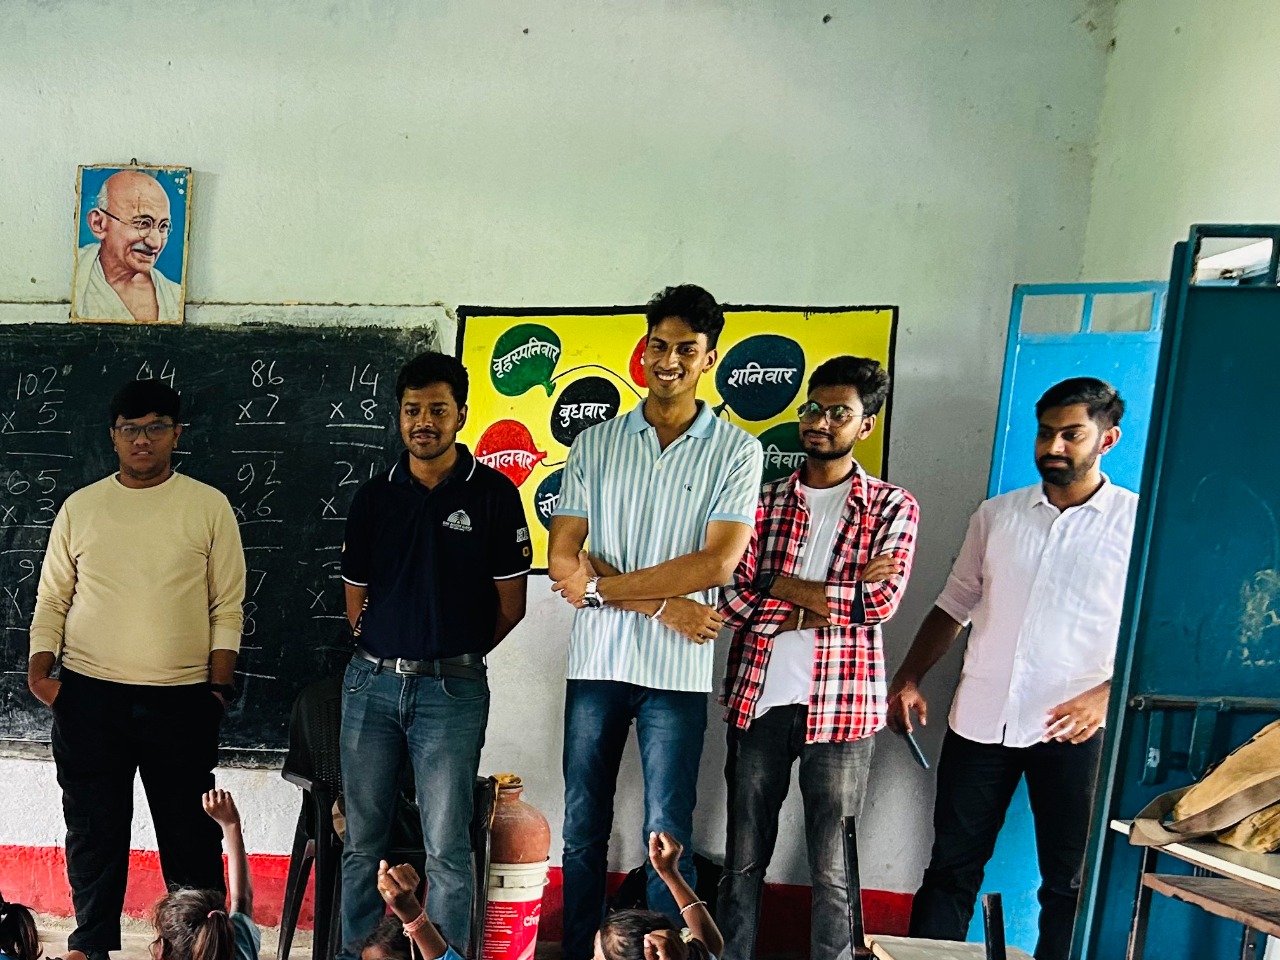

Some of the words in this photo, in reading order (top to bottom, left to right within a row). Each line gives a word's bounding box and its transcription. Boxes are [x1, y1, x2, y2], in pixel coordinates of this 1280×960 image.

[250, 359, 284, 388] 86
[727, 362, 797, 388] शनिवार
[37, 401, 63, 425] 5
[266, 393, 280, 417] 7
[360, 398, 378, 421] 8
[559, 402, 610, 427] बुधवार
[32, 498, 57, 523] 3
[253, 490, 275, 516] 6
